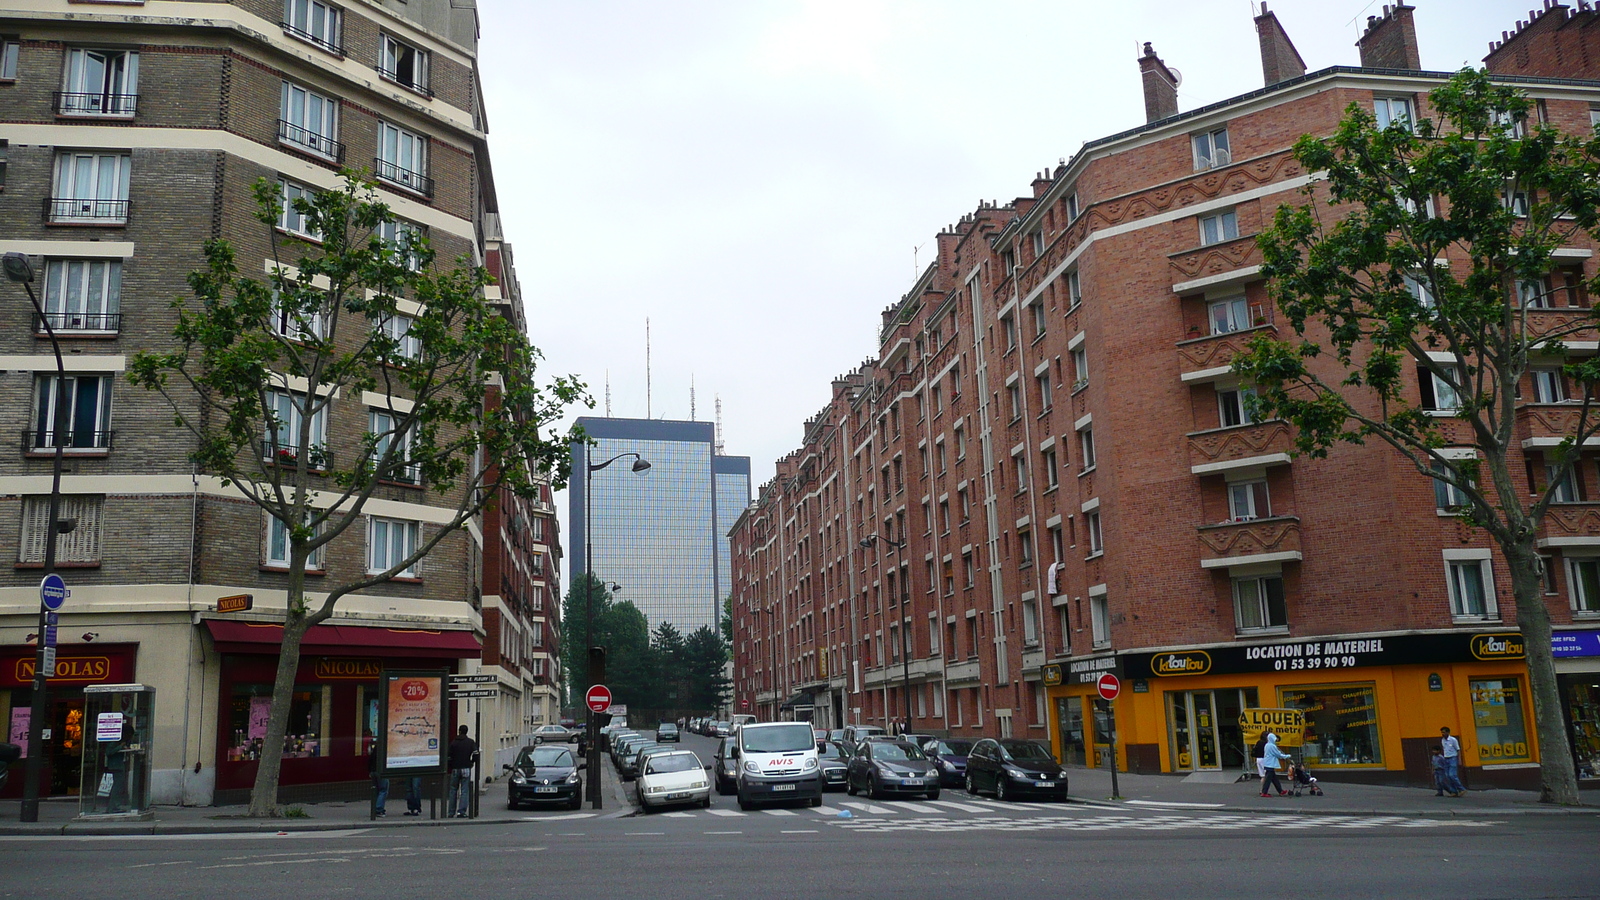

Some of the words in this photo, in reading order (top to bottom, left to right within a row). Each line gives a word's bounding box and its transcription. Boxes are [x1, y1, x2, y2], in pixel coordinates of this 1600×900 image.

[220, 598, 245, 609] NICOLAS
[1246, 644, 1302, 660] LOCATION
[1306, 643, 1320, 656] DE
[1324, 640, 1383, 655] MATERIEL
[1480, 636, 1522, 655] kiloutou
[22, 662, 104, 676] NOLAS
[320, 661, 380, 674] NICOLAS
[1160, 655, 1204, 671] kiloutou
[1275, 660, 1287, 670] 01
[1291, 659, 1304, 670] 53
[1308, 658, 1321, 669] 39
[1324, 657, 1338, 668] 90
[1341, 656, 1355, 667] 90
[1253, 712, 1302, 725] LOUER
